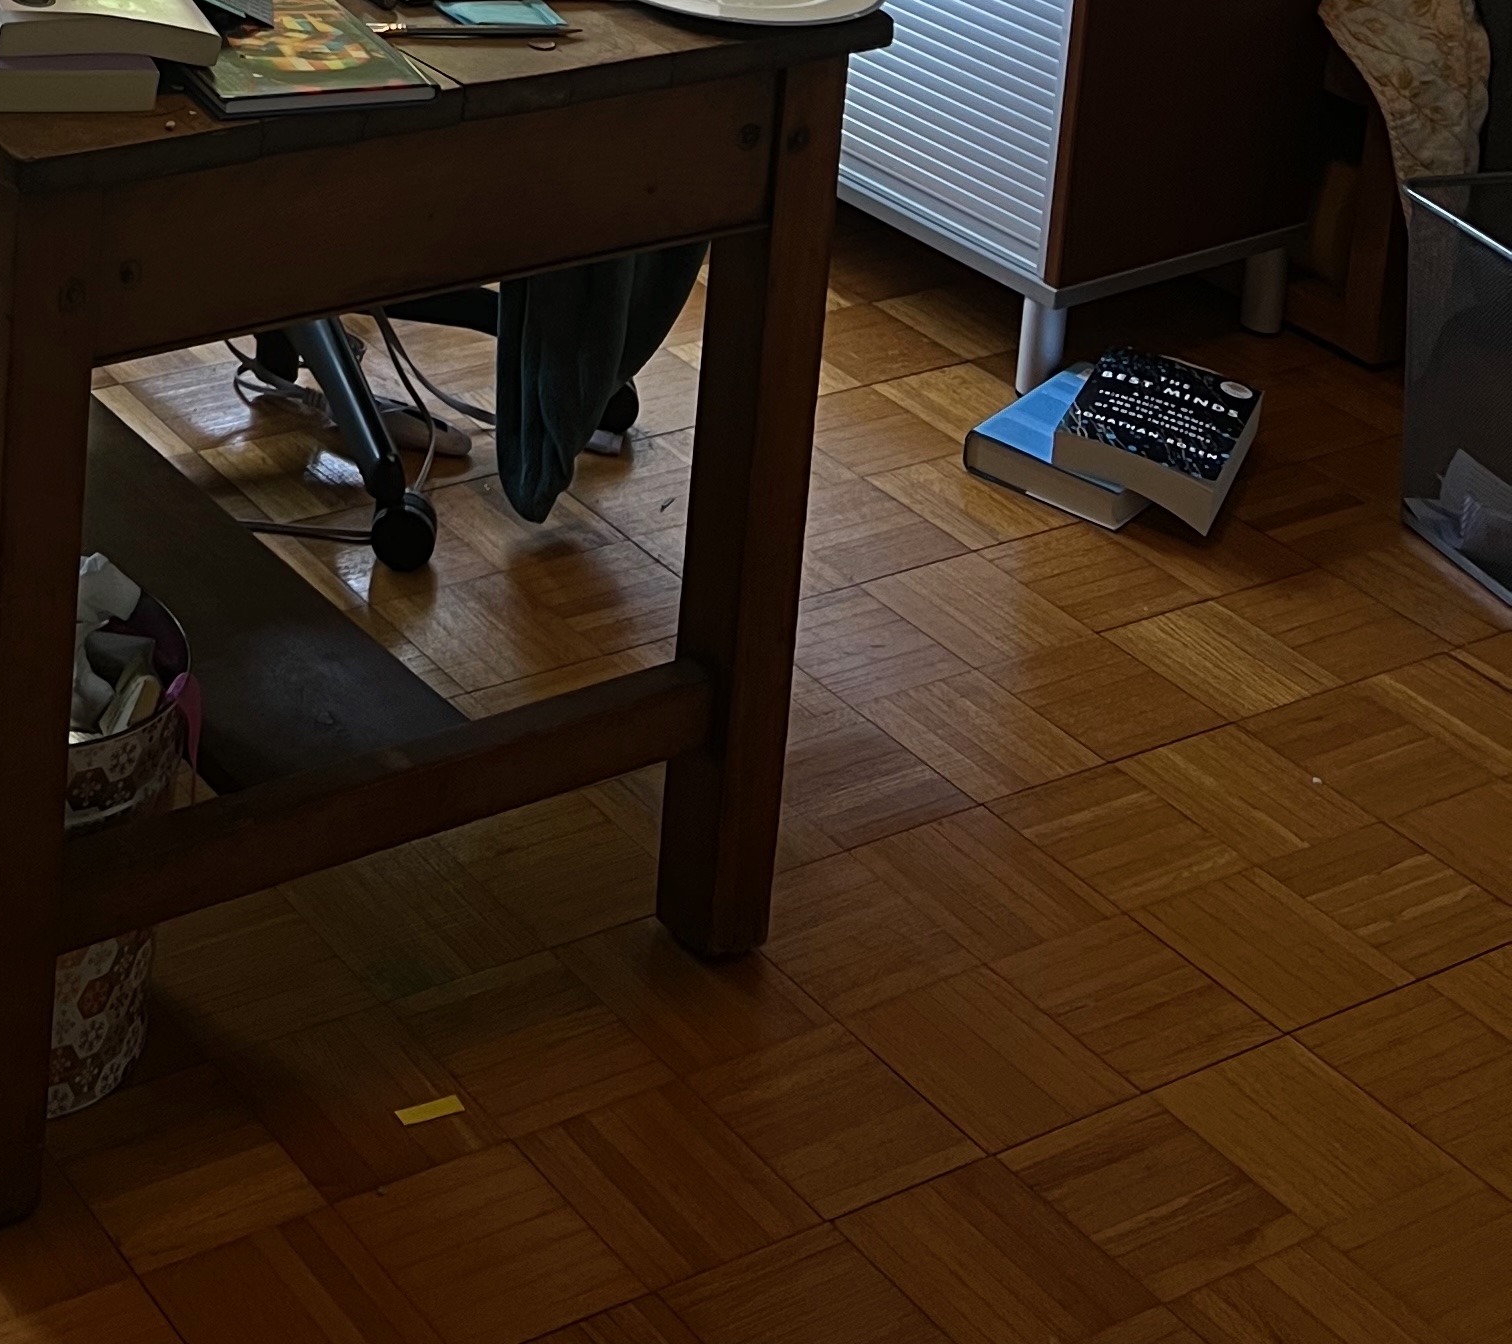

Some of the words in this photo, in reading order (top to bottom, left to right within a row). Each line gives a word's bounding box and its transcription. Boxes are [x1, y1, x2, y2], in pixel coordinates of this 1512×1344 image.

[1101, 370, 1154, 388] BEST
[1163, 387, 1239, 418] MINDS
[1160, 375, 1192, 391] THE
[1075, 410, 1159, 439] JONATHAN
